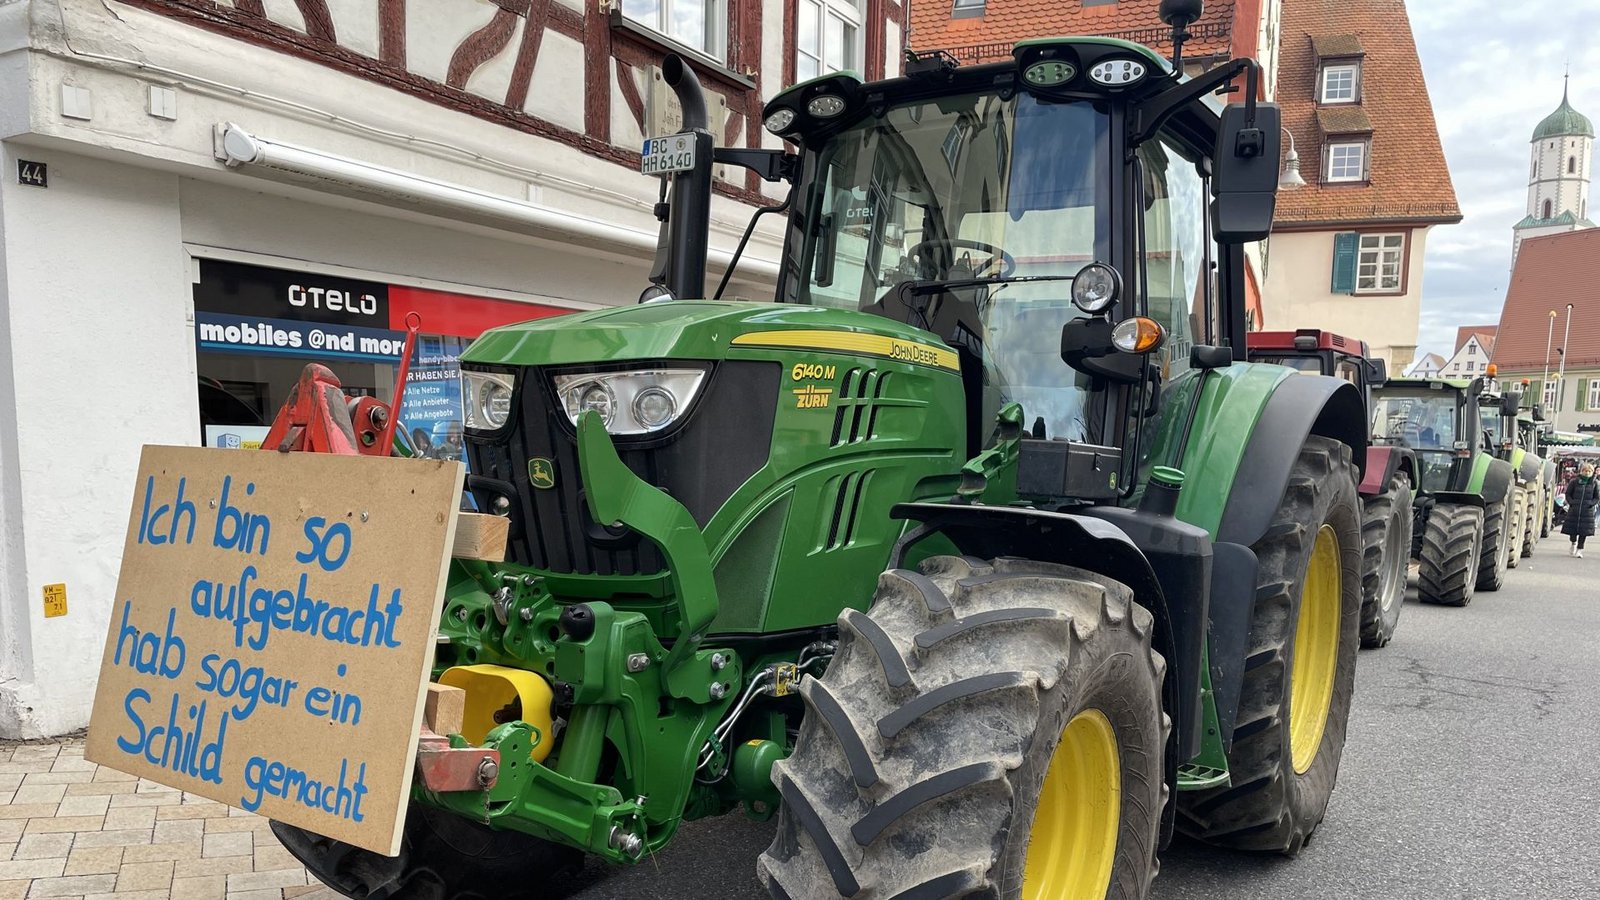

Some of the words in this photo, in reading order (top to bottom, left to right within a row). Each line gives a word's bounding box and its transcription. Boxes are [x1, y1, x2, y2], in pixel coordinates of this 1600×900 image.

[651, 139, 668, 154] BC
[660, 153, 691, 170] 6140
[22, 164, 43, 184] 44
[200, 323, 302, 348] mobiles
[308, 329, 354, 352] @nd
[415, 371, 443, 381] HABEN
[444, 370, 456, 379] SIE
[408, 387, 420, 395] Alle
[421, 386, 440, 394] Netze
[423, 398, 449, 407] Anbieter
[410, 412, 423, 420] Alle
[424, 409, 453, 419] Angebote
[139, 477, 195, 544] Ich
[214, 476, 270, 555] bin
[296, 517, 352, 572] so
[192, 566, 402, 651] aufgebracht
[115, 602, 186, 679] hab
[196, 654, 298, 721] sogar
[305, 664, 361, 725] ein
[118, 689, 229, 785] Schild
[242, 757, 368, 822] gemacht
